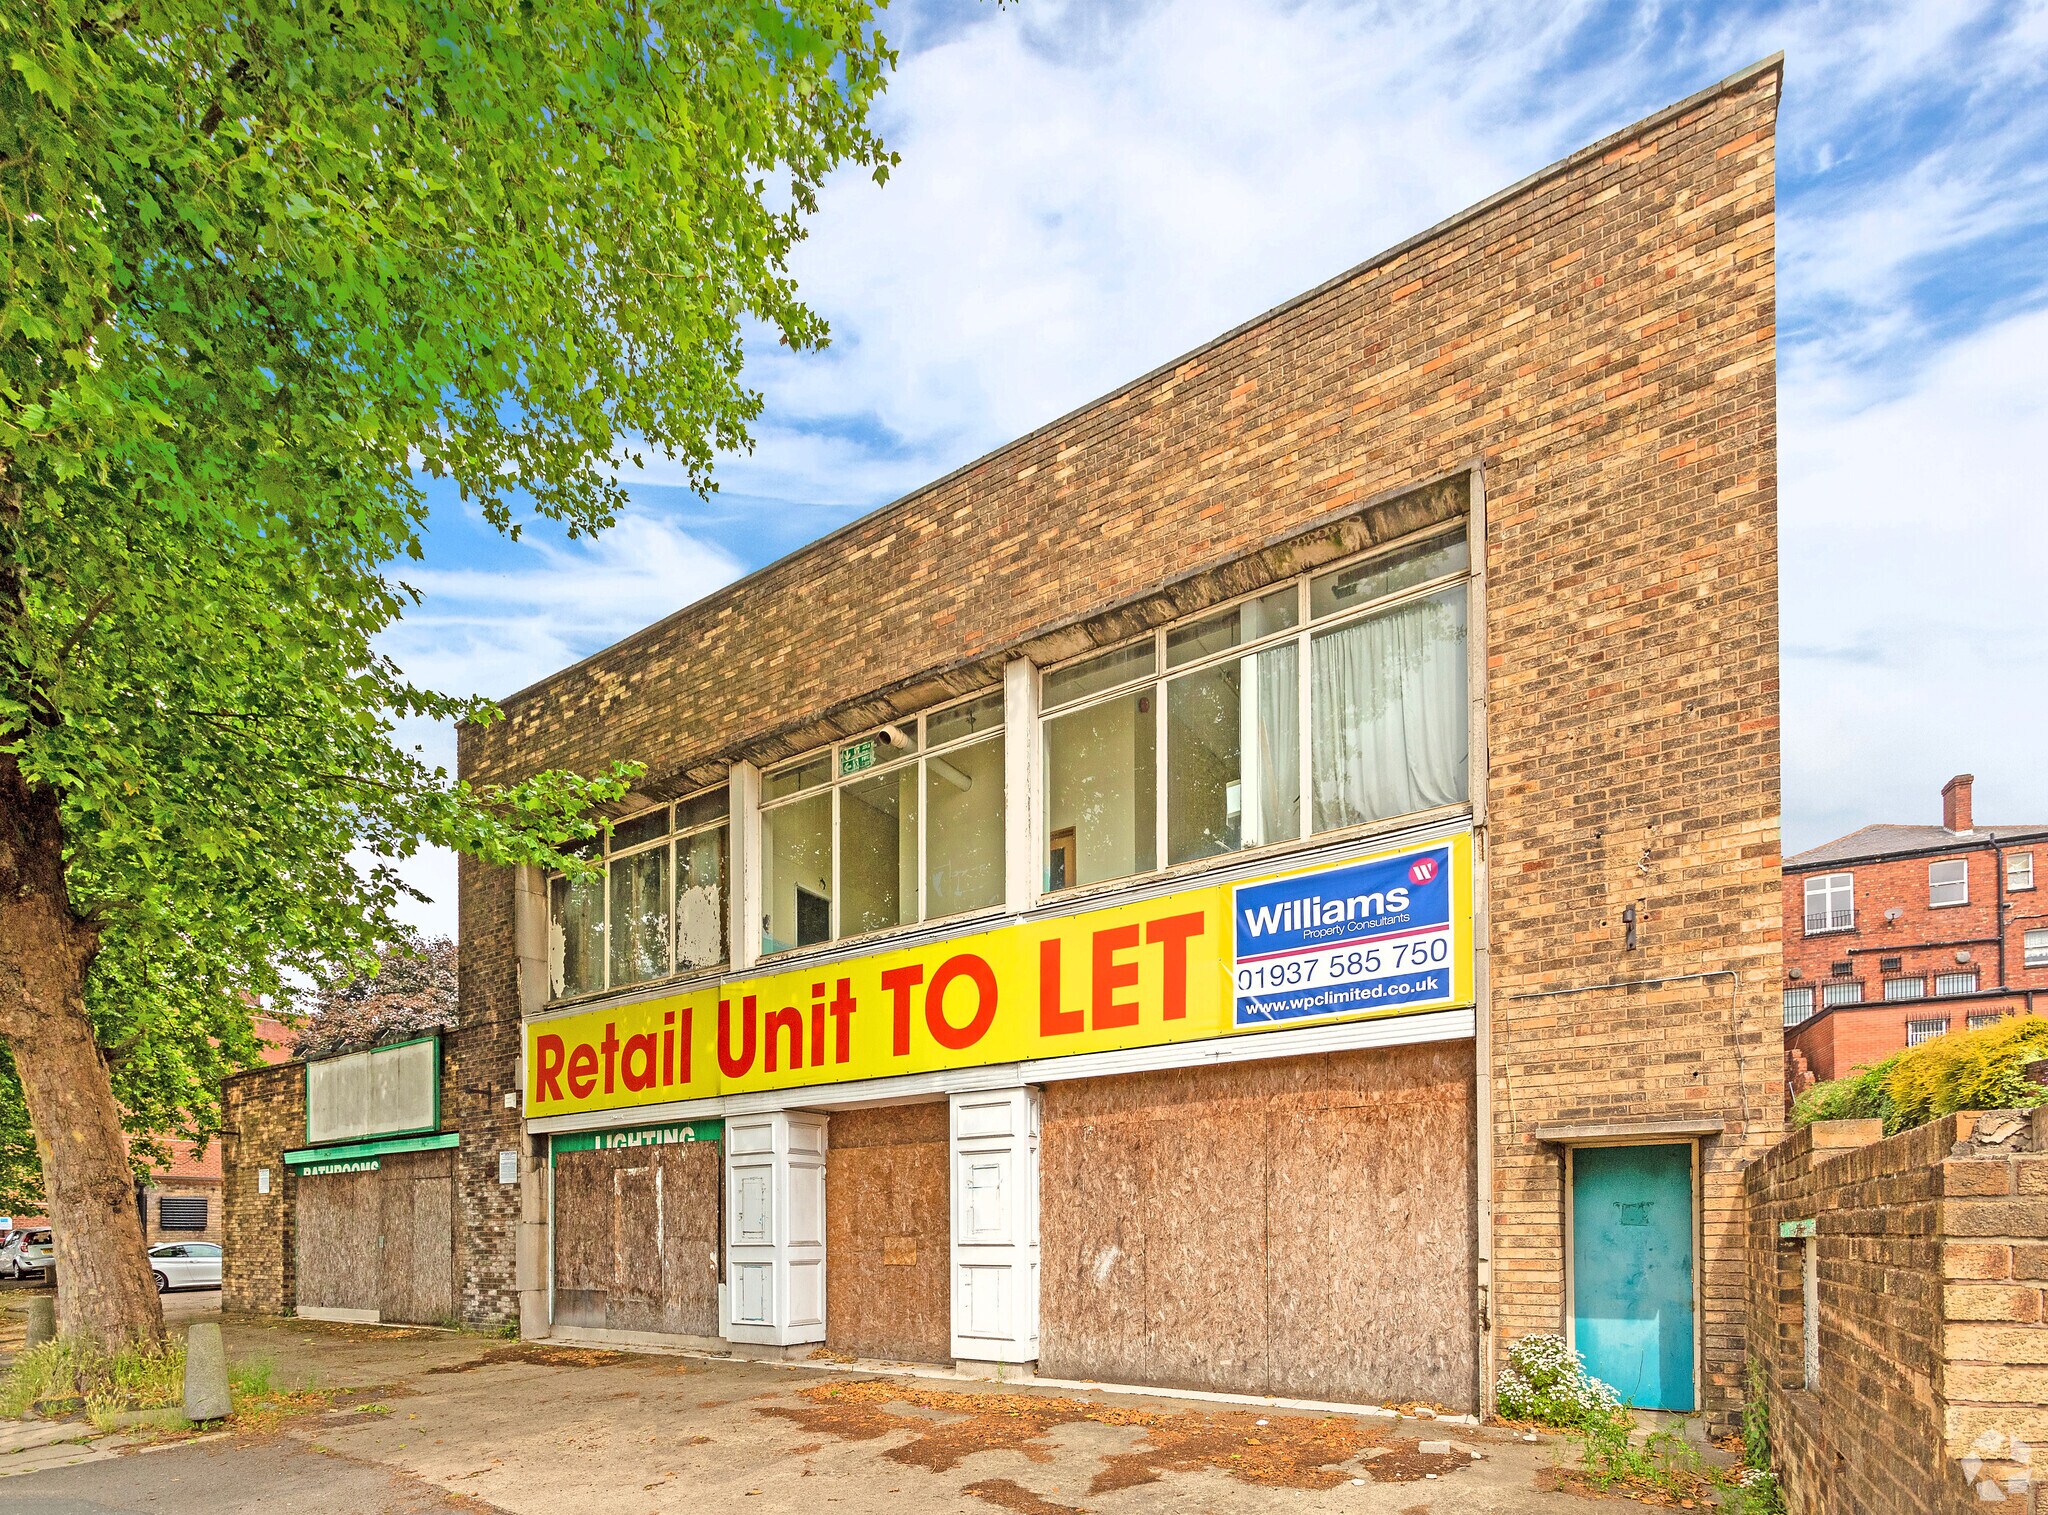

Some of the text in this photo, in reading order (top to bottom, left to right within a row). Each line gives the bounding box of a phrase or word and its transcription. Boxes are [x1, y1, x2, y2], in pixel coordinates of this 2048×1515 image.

[1244, 887, 1410, 938] Williams
[1303, 912, 1411, 940] Property Consultants
[1238, 938, 1447, 991] 01937 585 750
[535, 911, 1205, 1102] Retail Unit TO LET
[1245, 976, 1439, 1015] www.wpclimited.co.uk
